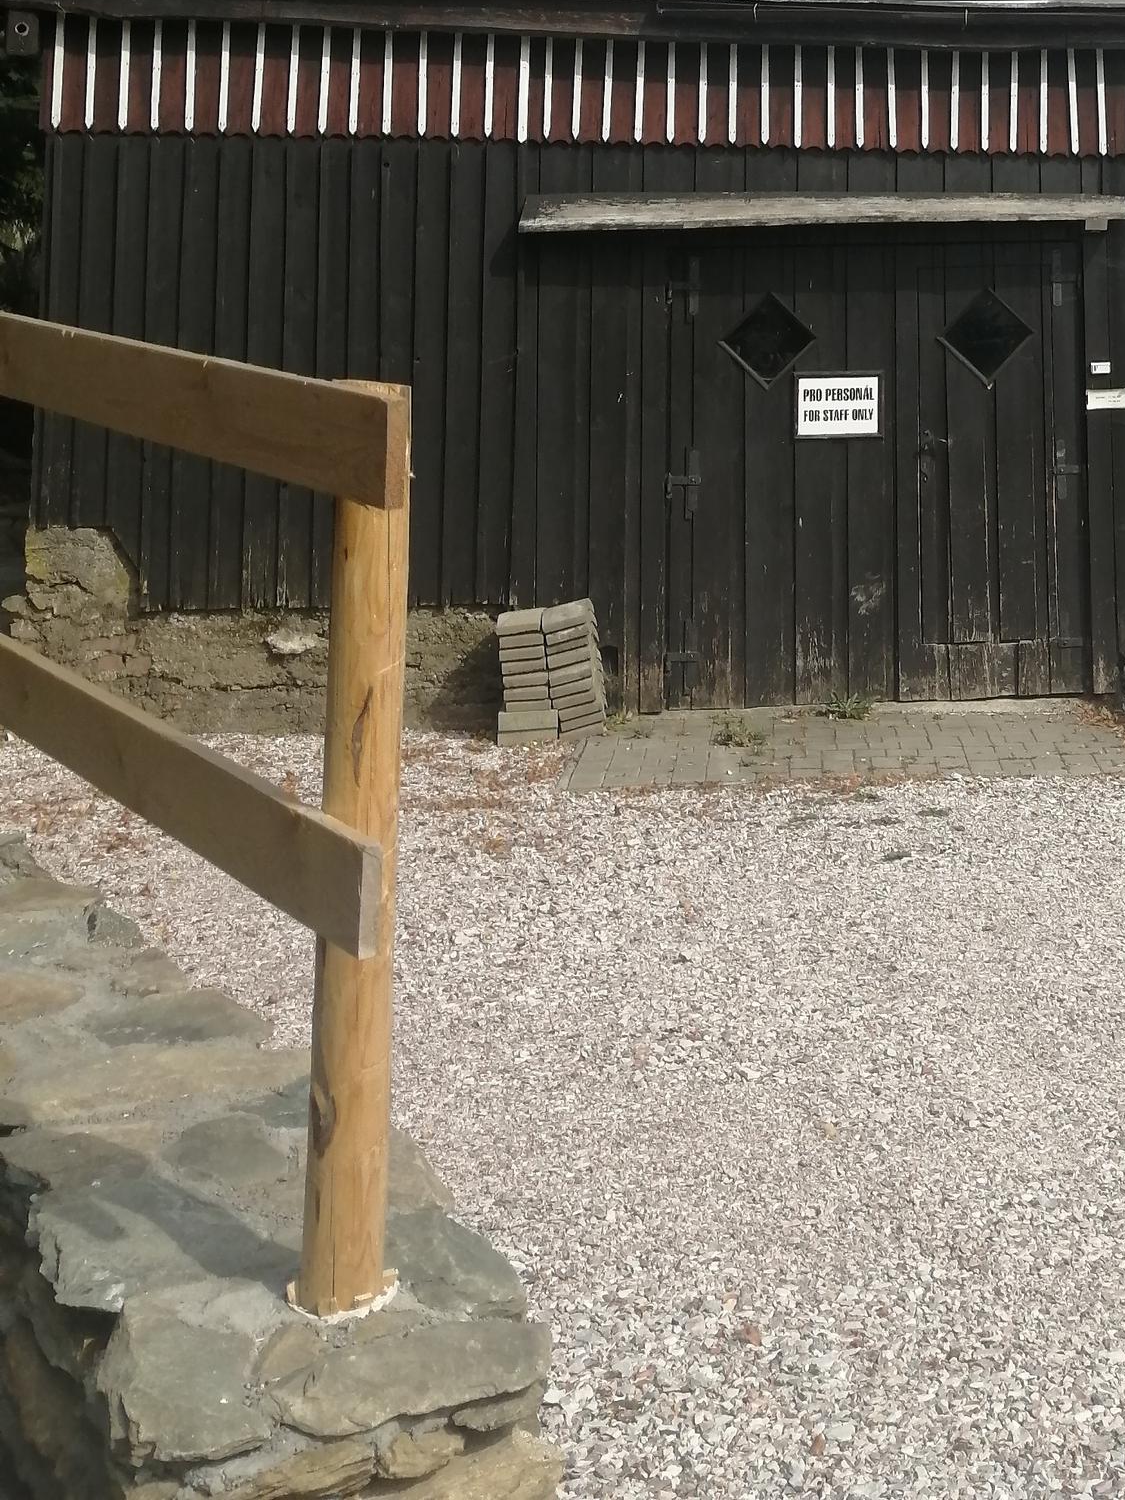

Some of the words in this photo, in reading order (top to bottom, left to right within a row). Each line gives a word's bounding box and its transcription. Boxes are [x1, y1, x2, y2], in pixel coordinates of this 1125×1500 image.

[803, 388, 822, 402] PRO
[825, 385, 875, 401] PERSONÁL
[803, 409, 820, 422] FOR
[823, 408, 849, 421] STAFF
[852, 408, 873, 420] ONLY
